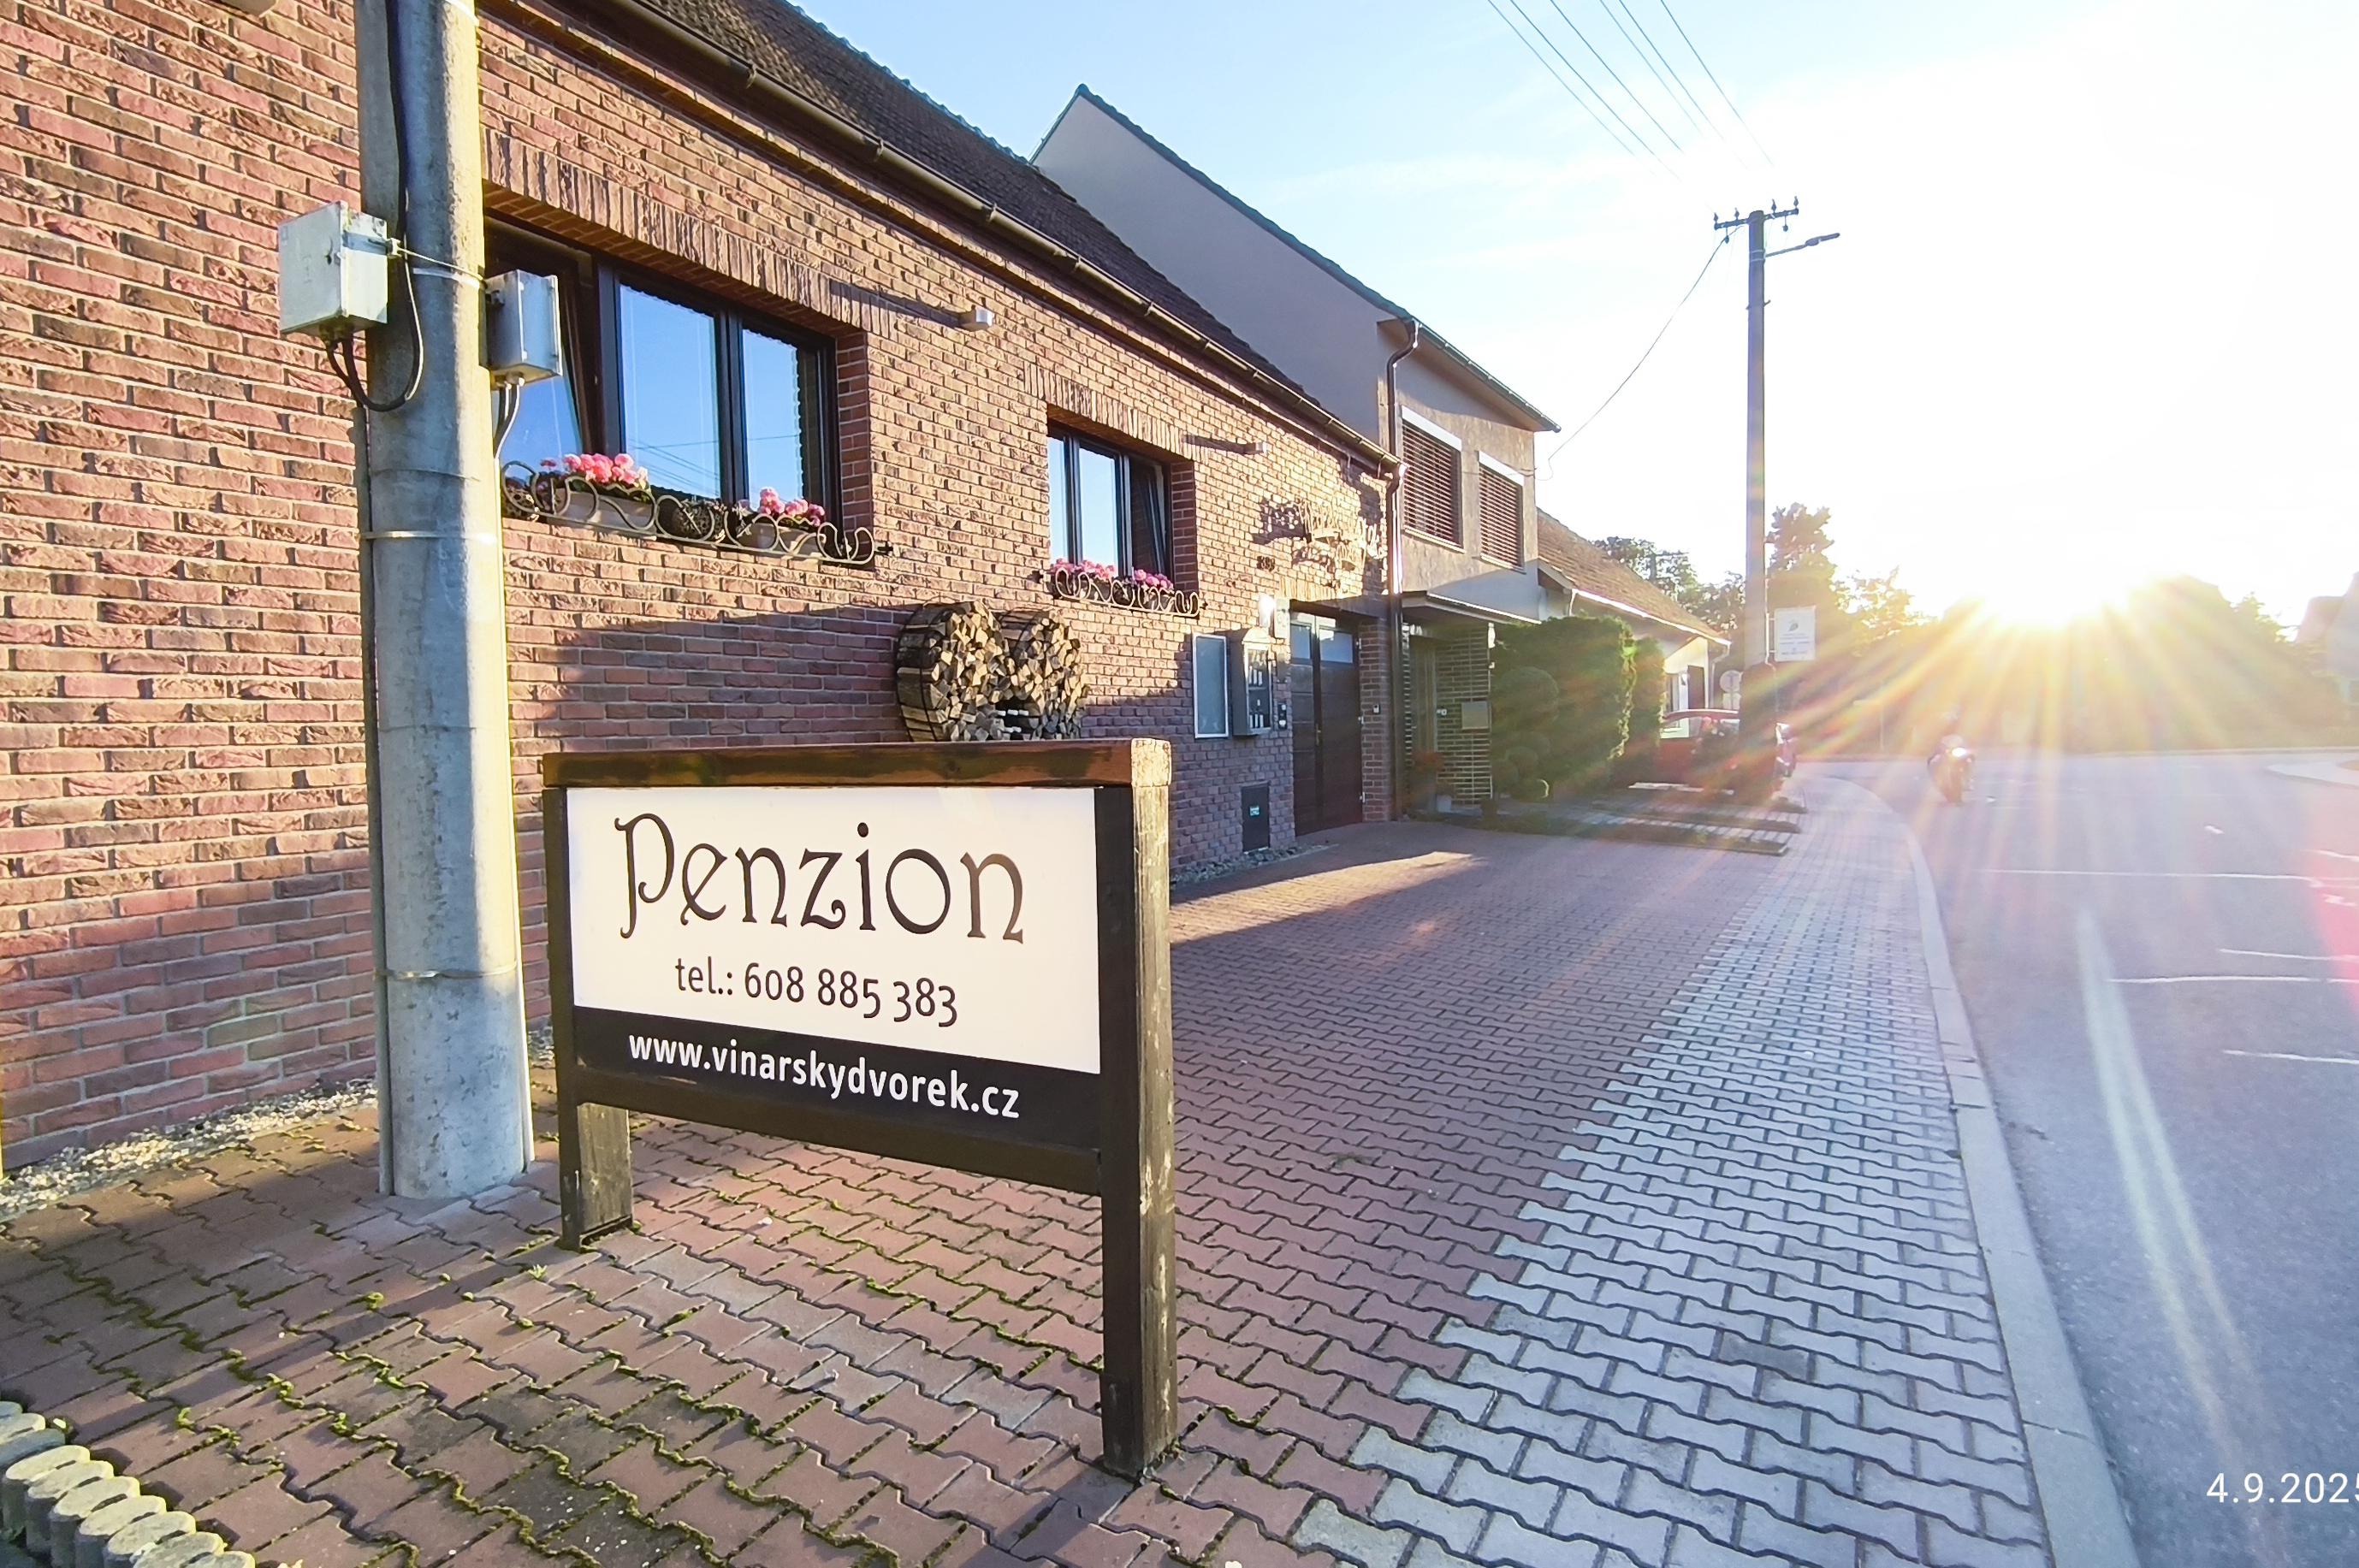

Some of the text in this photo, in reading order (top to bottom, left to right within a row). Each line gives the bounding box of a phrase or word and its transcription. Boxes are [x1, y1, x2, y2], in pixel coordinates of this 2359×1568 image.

[613, 813, 1023, 944] Penzion
[674, 956, 957, 1027] tel.: 608 885 383
[629, 1034, 1020, 1119] www.vinarskydvorek.cz
